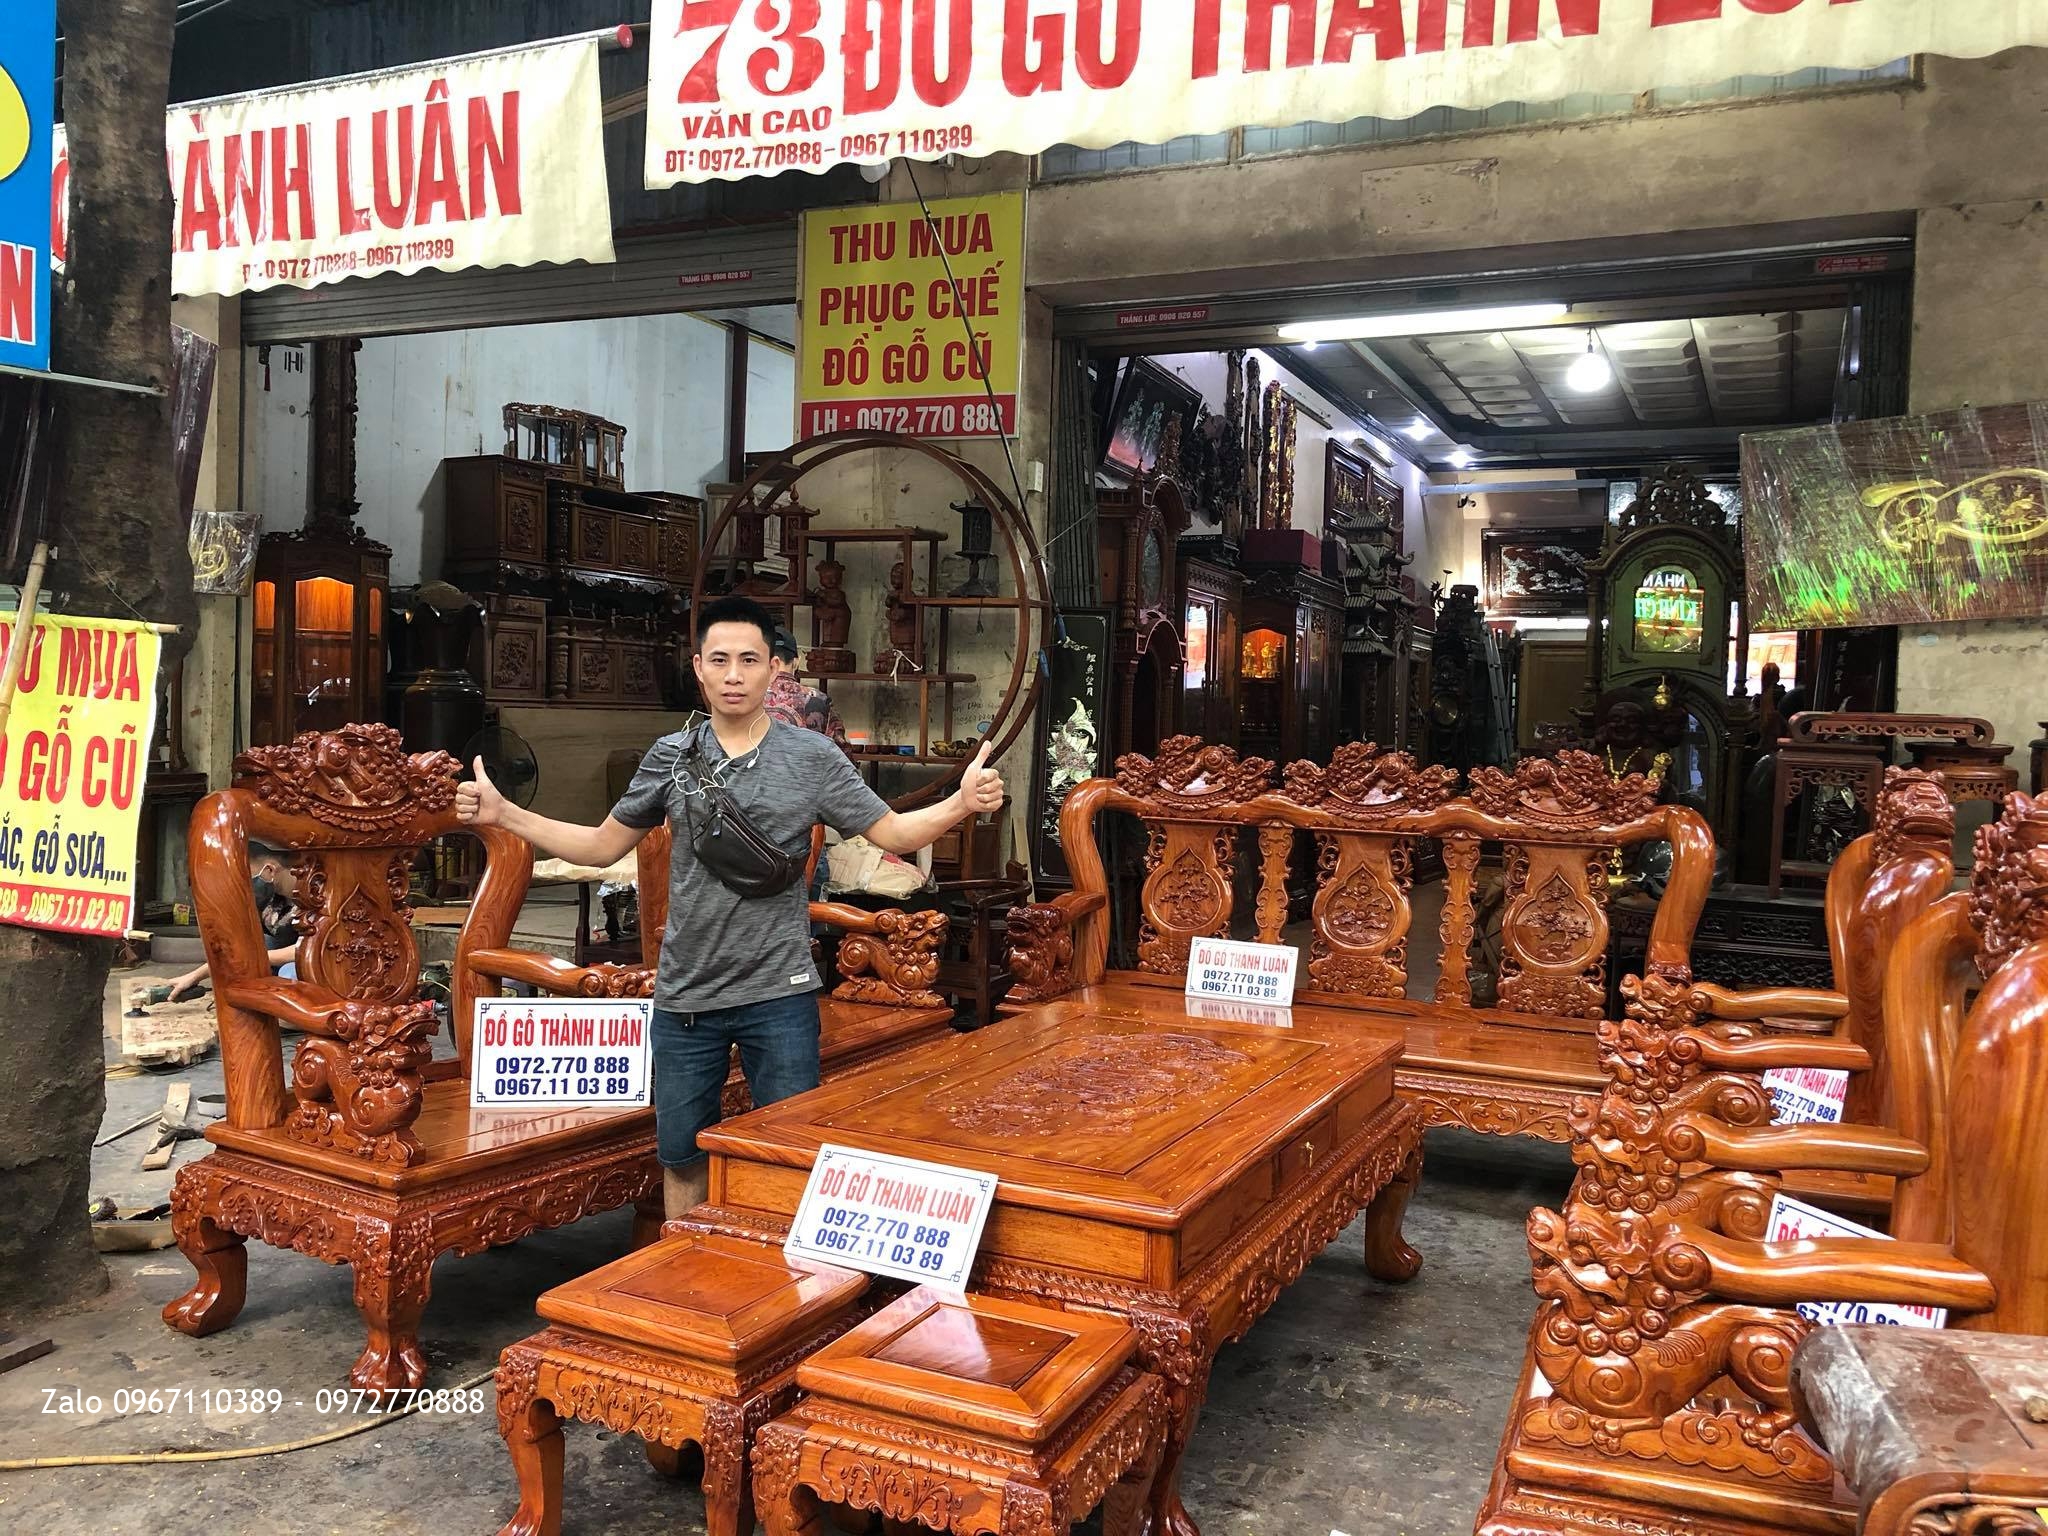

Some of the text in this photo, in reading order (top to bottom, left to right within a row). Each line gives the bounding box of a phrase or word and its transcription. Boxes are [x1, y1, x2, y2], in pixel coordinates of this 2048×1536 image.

[682, 105, 832, 140] VĂN CAO
[336, 79, 522, 236] LUÂN
[829, 213, 994, 264] THU MUA
[819, 260, 1004, 331] PHỤC CHẾ
[823, 327, 992, 386] ĐỒ GỖ CŨ
[962, 403, 1004, 432] 888
[56, 627, 140, 701] MUA
[19, 704, 72, 804] GỖ
[82, 724, 138, 810] CŨ
[32, 814, 61, 874] GỖ
[1201, 981, 1277, 998] 0967.11 03 89
[1203, 969, 1278, 987] 0972.770 888
[485, 1009, 642, 1047] ĐỒ GỖ THÀNH LUÂN
[495, 1057, 630, 1074] 0972.770 888
[495, 1078, 629, 1095] 0967.11 03 89
[1816, 1104, 1837, 1121] 888
[819, 1162, 976, 1225] ĐỒ GỖ THÀNH LUÂN
[823, 1207, 950, 1248] 0972.770 888
[815, 1228, 944, 1271] 0967.11 03 89
